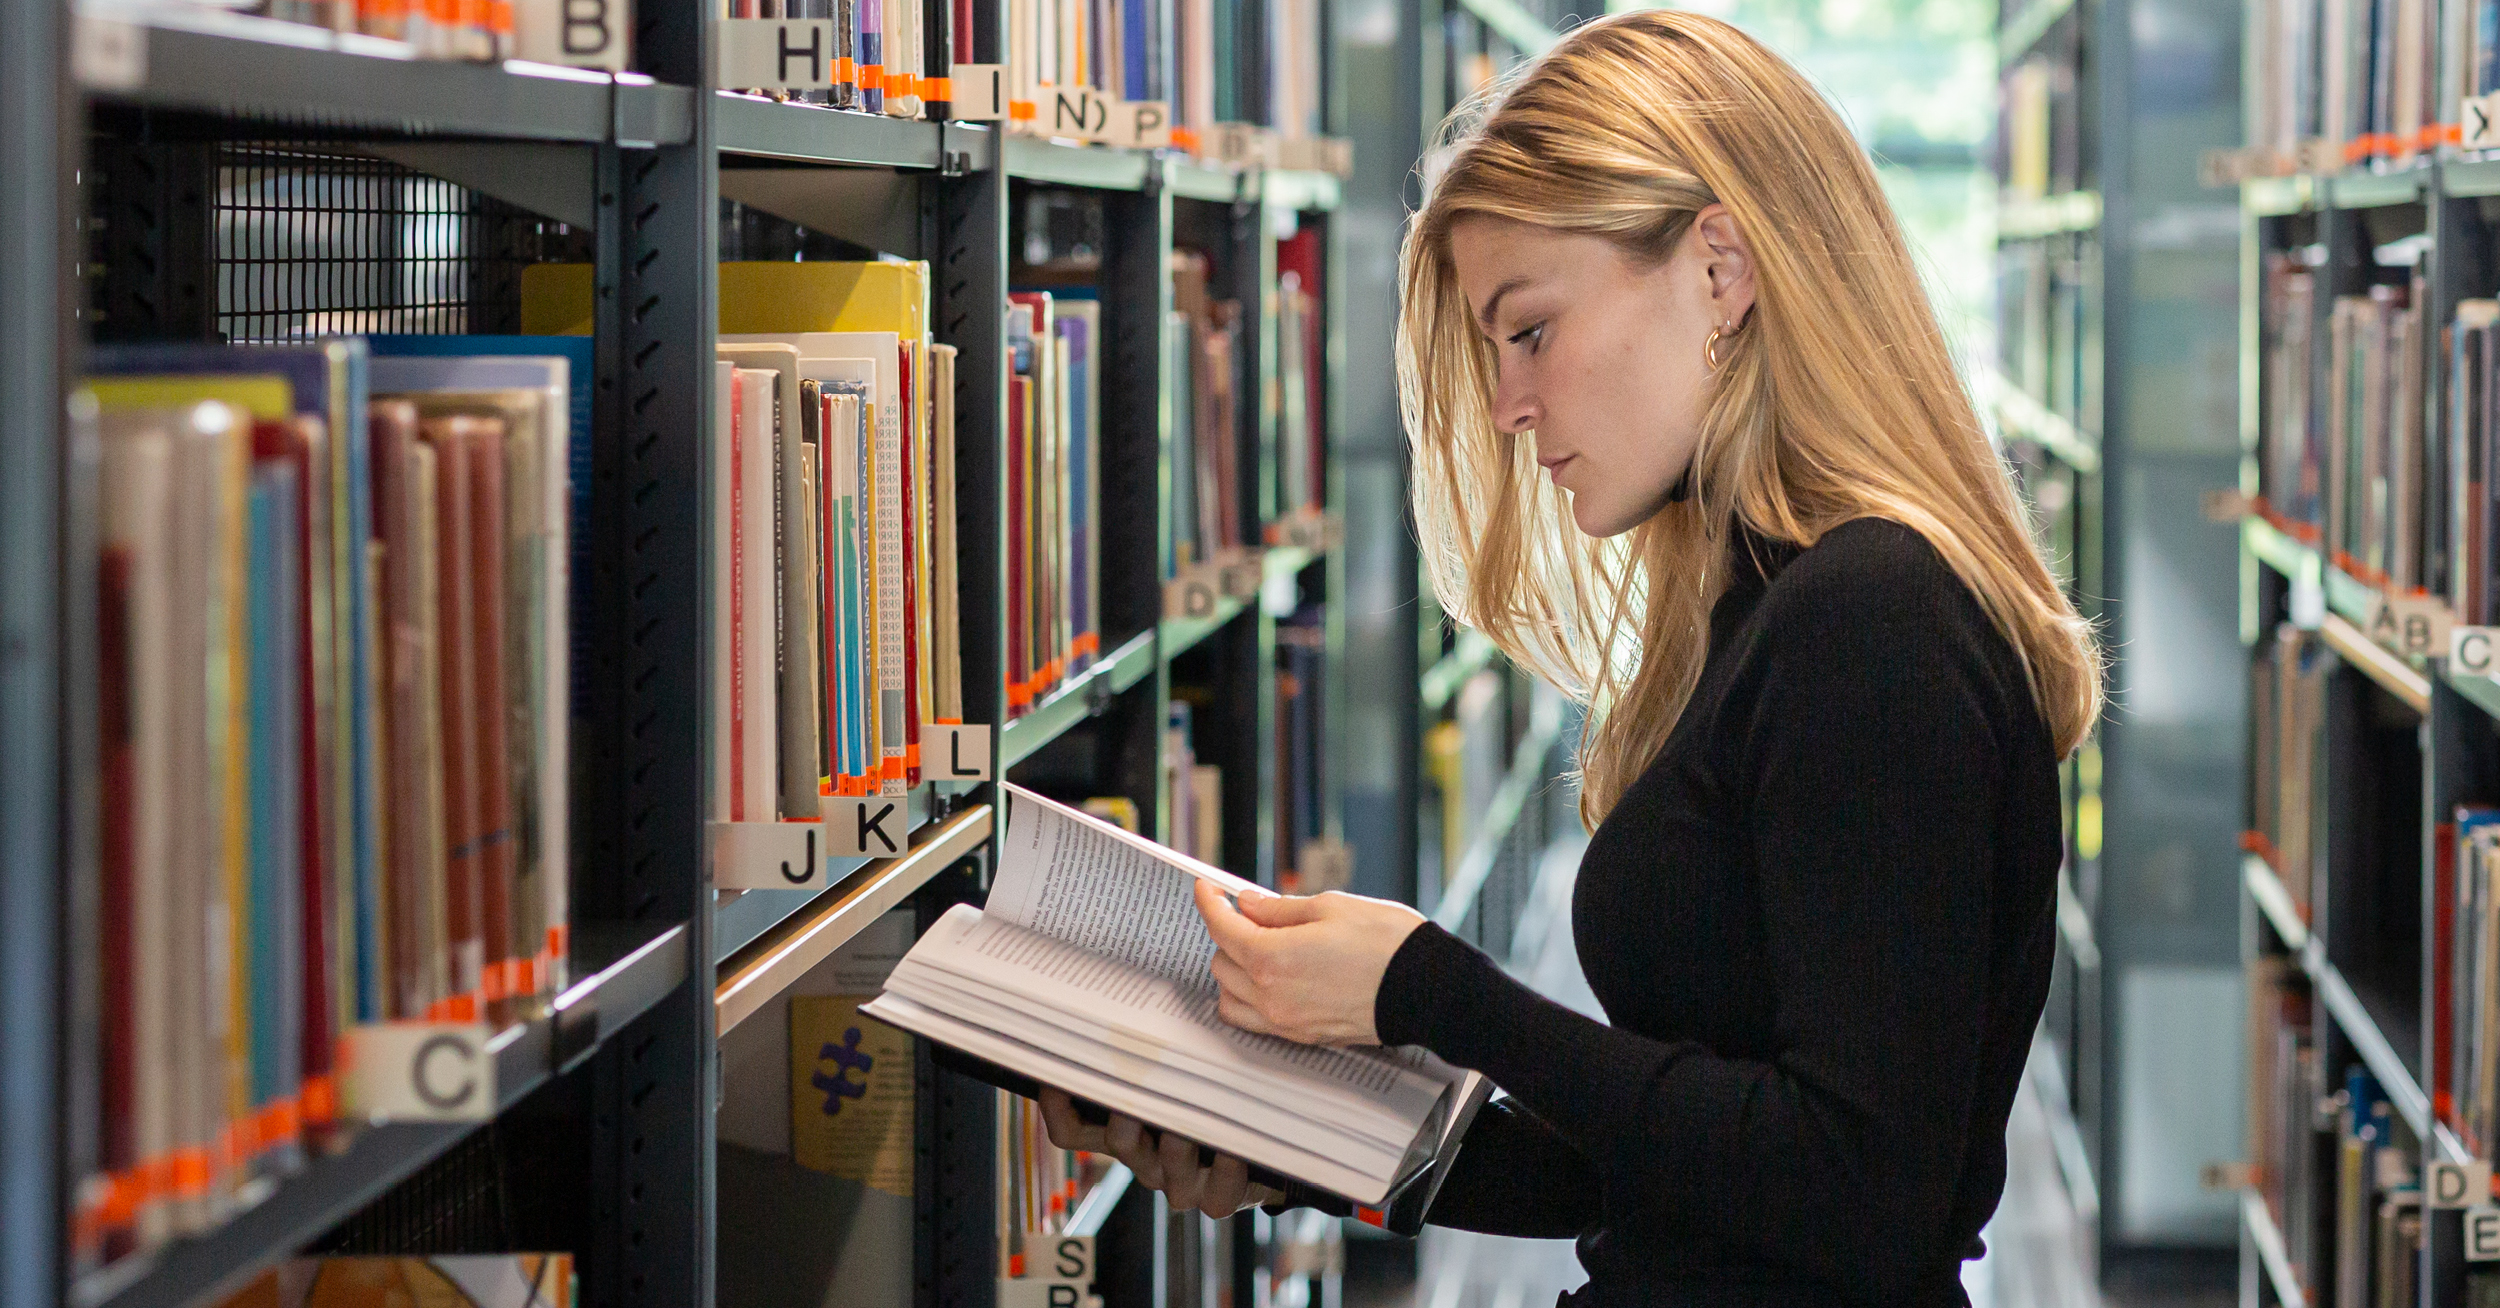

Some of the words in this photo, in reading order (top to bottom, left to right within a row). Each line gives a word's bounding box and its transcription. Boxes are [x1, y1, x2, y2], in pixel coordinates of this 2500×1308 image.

[562, 0, 609, 55] B
[778, 26, 820, 82] H
[992, 70, 1000, 114] I
[1056, 93, 1087, 130] N
[1135, 107, 1163, 142] P
[2371, 603, 2399, 632] A
[2404, 616, 2430, 648] B
[2458, 634, 2492, 671] C
[951, 730, 981, 776] L
[857, 802, 898, 853] K
[780, 829, 816, 884] J
[1047, 896, 1064, 931] neuroculture
[1062, 893, 1076, 914] century
[1084, 909, 1100, 934] practices
[1064, 921, 1076, 941] porary
[1141, 946, 1154, 969] equency
[412, 1032, 479, 1110] C
[2435, 1166, 2467, 1203] D
[2474, 1215, 2500, 1254] E
[1056, 1239, 1086, 1278] S
